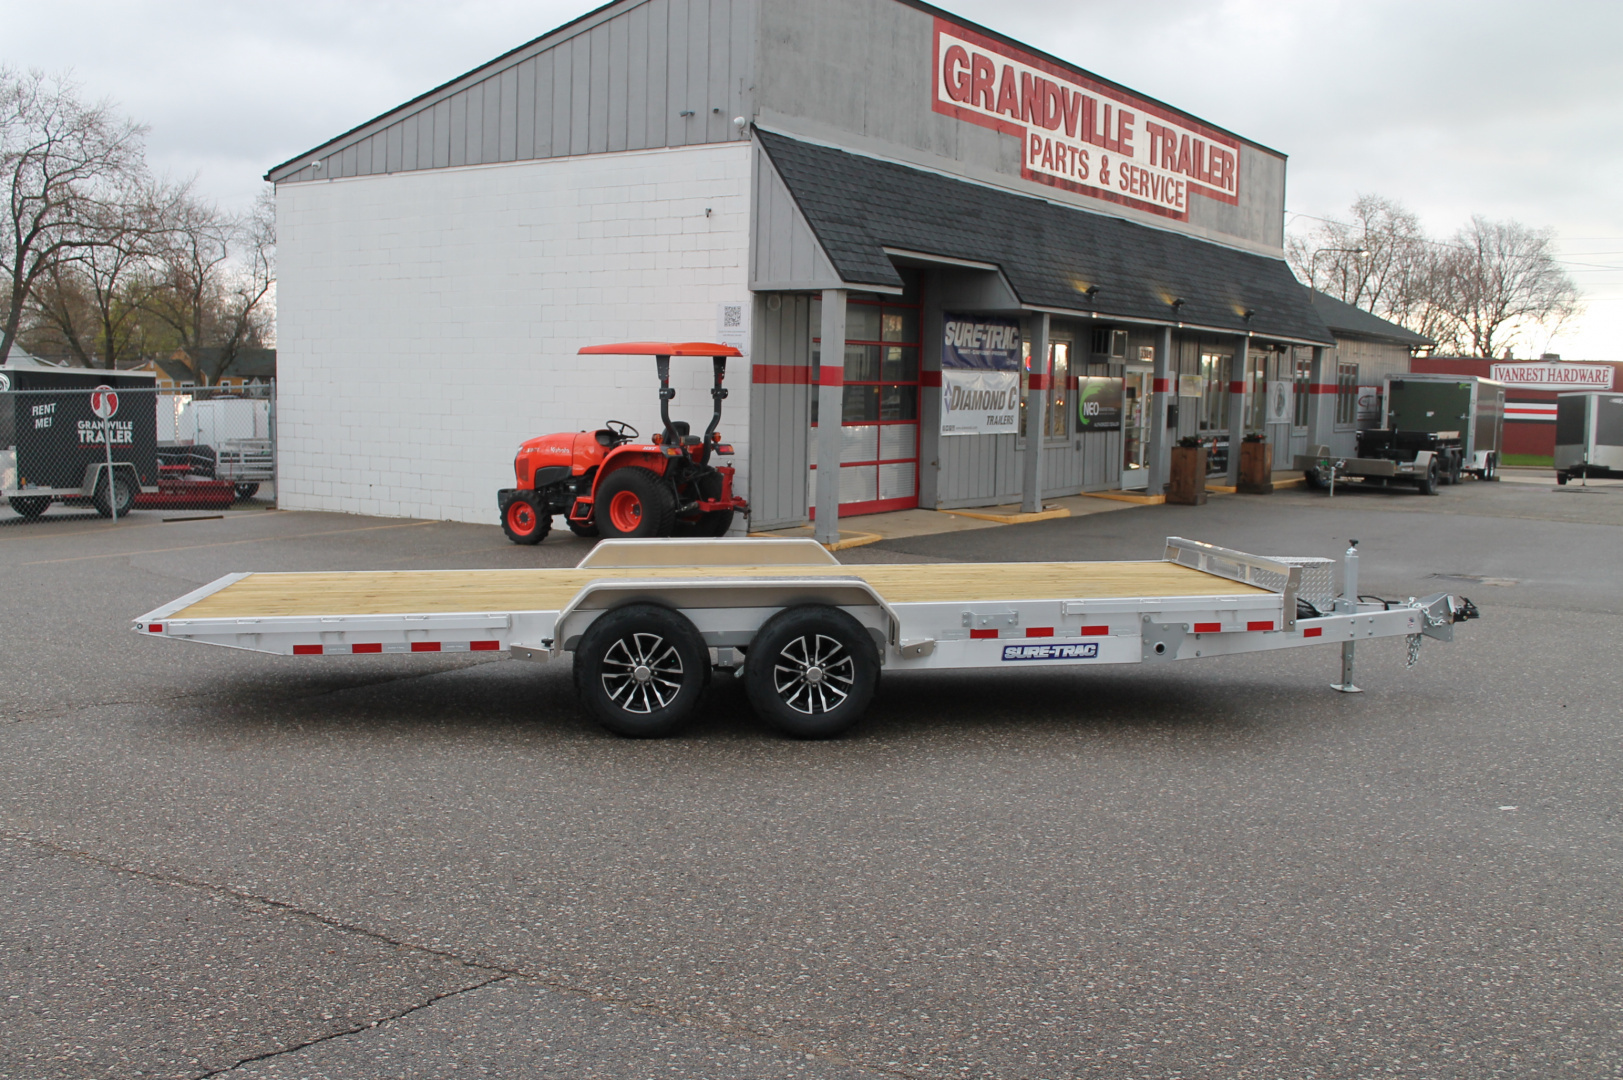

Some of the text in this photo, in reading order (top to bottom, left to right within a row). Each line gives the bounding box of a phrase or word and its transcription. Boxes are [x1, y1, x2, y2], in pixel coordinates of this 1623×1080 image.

[943, 45, 1235, 191] GRANDVILLE TRAILER
[1029, 133, 1185, 208] PARTS & SERVICE
[944, 321, 1019, 350] SURE-TRAC
[1494, 367, 1609, 383] IVANREST HARDWARE
[950, 385, 1017, 411] DIAMOND C
[32, 403, 56, 416] RENT
[1083, 401, 1100, 416] NEO
[35, 417, 52, 429] ME!
[77, 420, 133, 430] GRANVILLE
[987, 415, 1014, 425] TRAILERS
[77, 430, 133, 443] TRALER
[1004, 644, 1096, 659] SURE-TRAC
